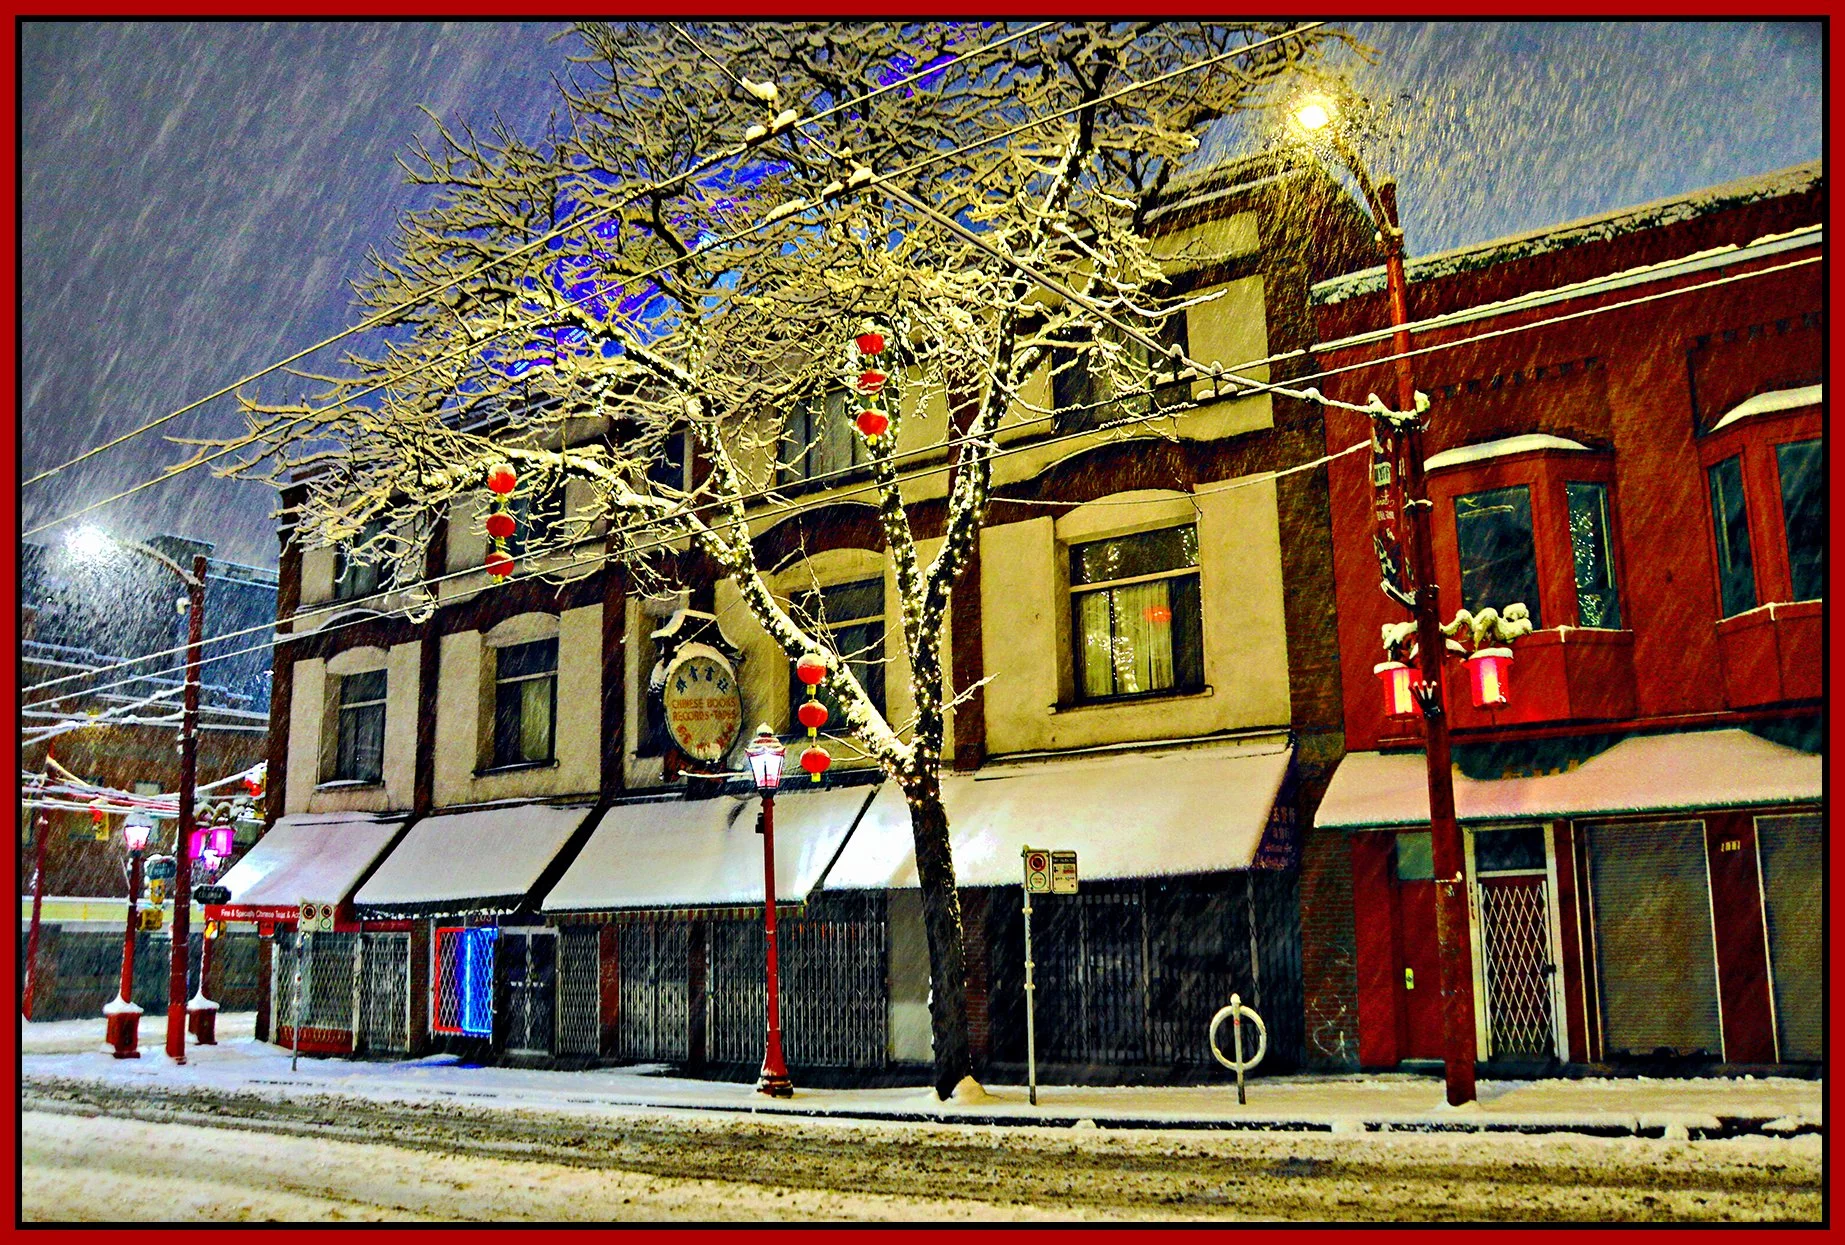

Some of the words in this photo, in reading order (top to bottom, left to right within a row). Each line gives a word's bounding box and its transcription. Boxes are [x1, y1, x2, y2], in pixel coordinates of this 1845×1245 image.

[671, 698, 704, 709] CHINESE
[707, 696, 737, 708] BOOKS
[672, 711, 709, 722] RECORDS
